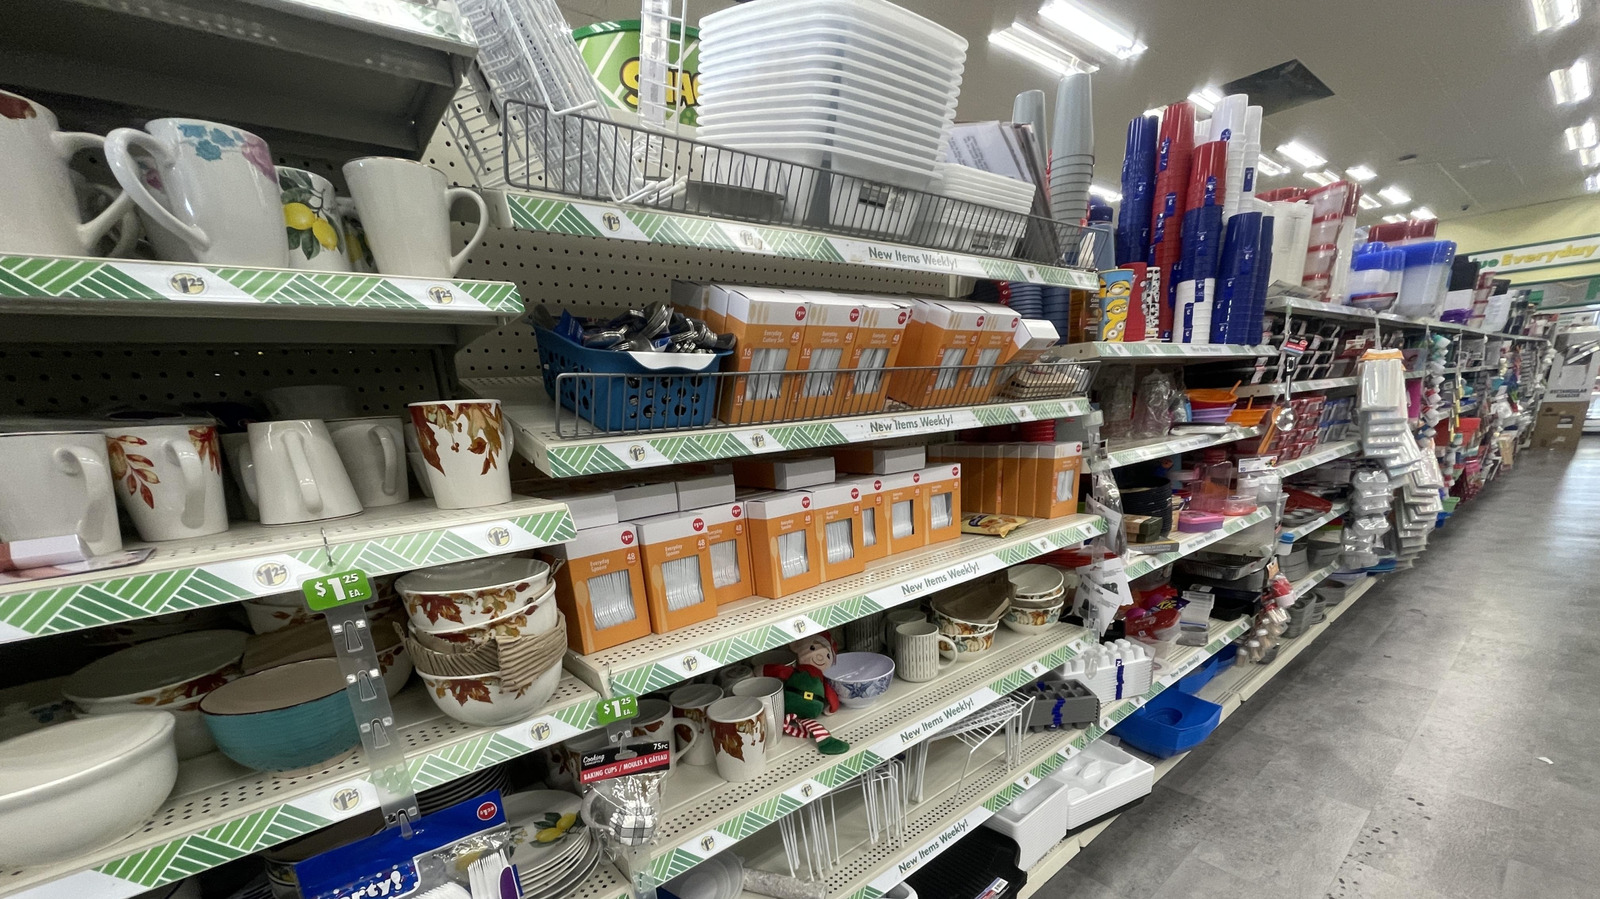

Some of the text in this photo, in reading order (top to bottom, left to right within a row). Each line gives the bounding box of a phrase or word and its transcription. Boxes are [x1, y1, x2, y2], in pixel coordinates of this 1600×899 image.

[868, 247, 958, 271] New Items Weekly!
[1501, 244, 1599, 266] Everyday
[791, 331, 800, 341] 48
[744, 348, 752, 357] 16
[870, 414, 954, 433] New Items Weekly!
[664, 544, 683, 552] Everyday
[590, 558, 610, 567] Everyday
[626, 552, 636, 560] 48
[901, 561, 980, 595] New Items Weekly!
[348, 588, 365, 598] EA.
[900, 697, 974, 743] New Items Weekly!
[583, 753, 605, 763] Cooking
[583, 769, 604, 781] BAKING
[604, 765, 618, 775] CUPS
[623, 759, 643, 769] MOULES
[648, 753, 668, 764] GÂTEAU
[898, 818, 969, 874] New Items Weekly!
